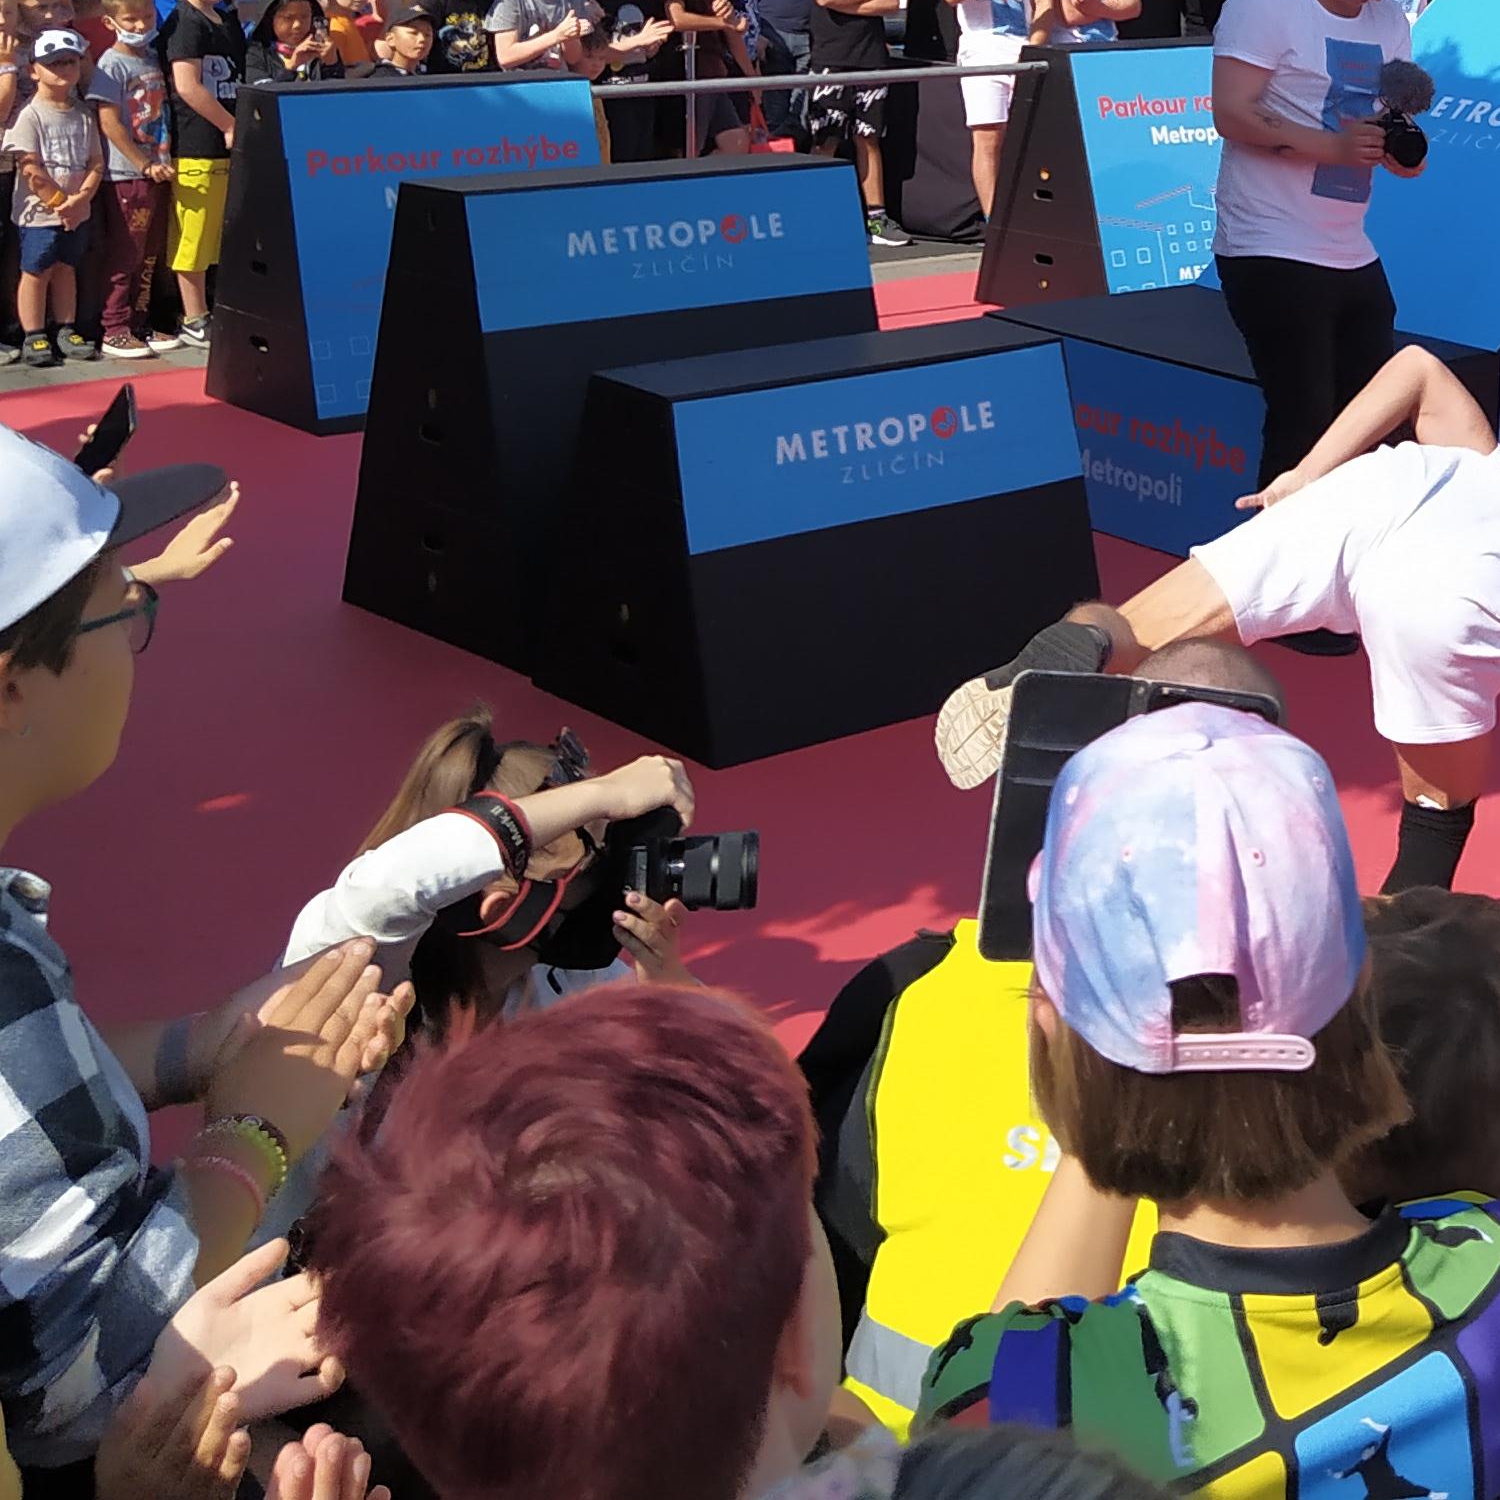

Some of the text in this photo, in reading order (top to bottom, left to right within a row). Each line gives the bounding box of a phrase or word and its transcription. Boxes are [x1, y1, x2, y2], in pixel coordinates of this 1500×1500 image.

[1097, 92, 1187, 121] Parkour
[306, 133, 580, 178] Parkour rozhýbe
[1150, 124, 1219, 145] Metrop
[567, 212, 785, 259] METROPOLE
[775, 400, 996, 465] METROPOLE
[1129, 417, 1247, 475] rozhýbe
